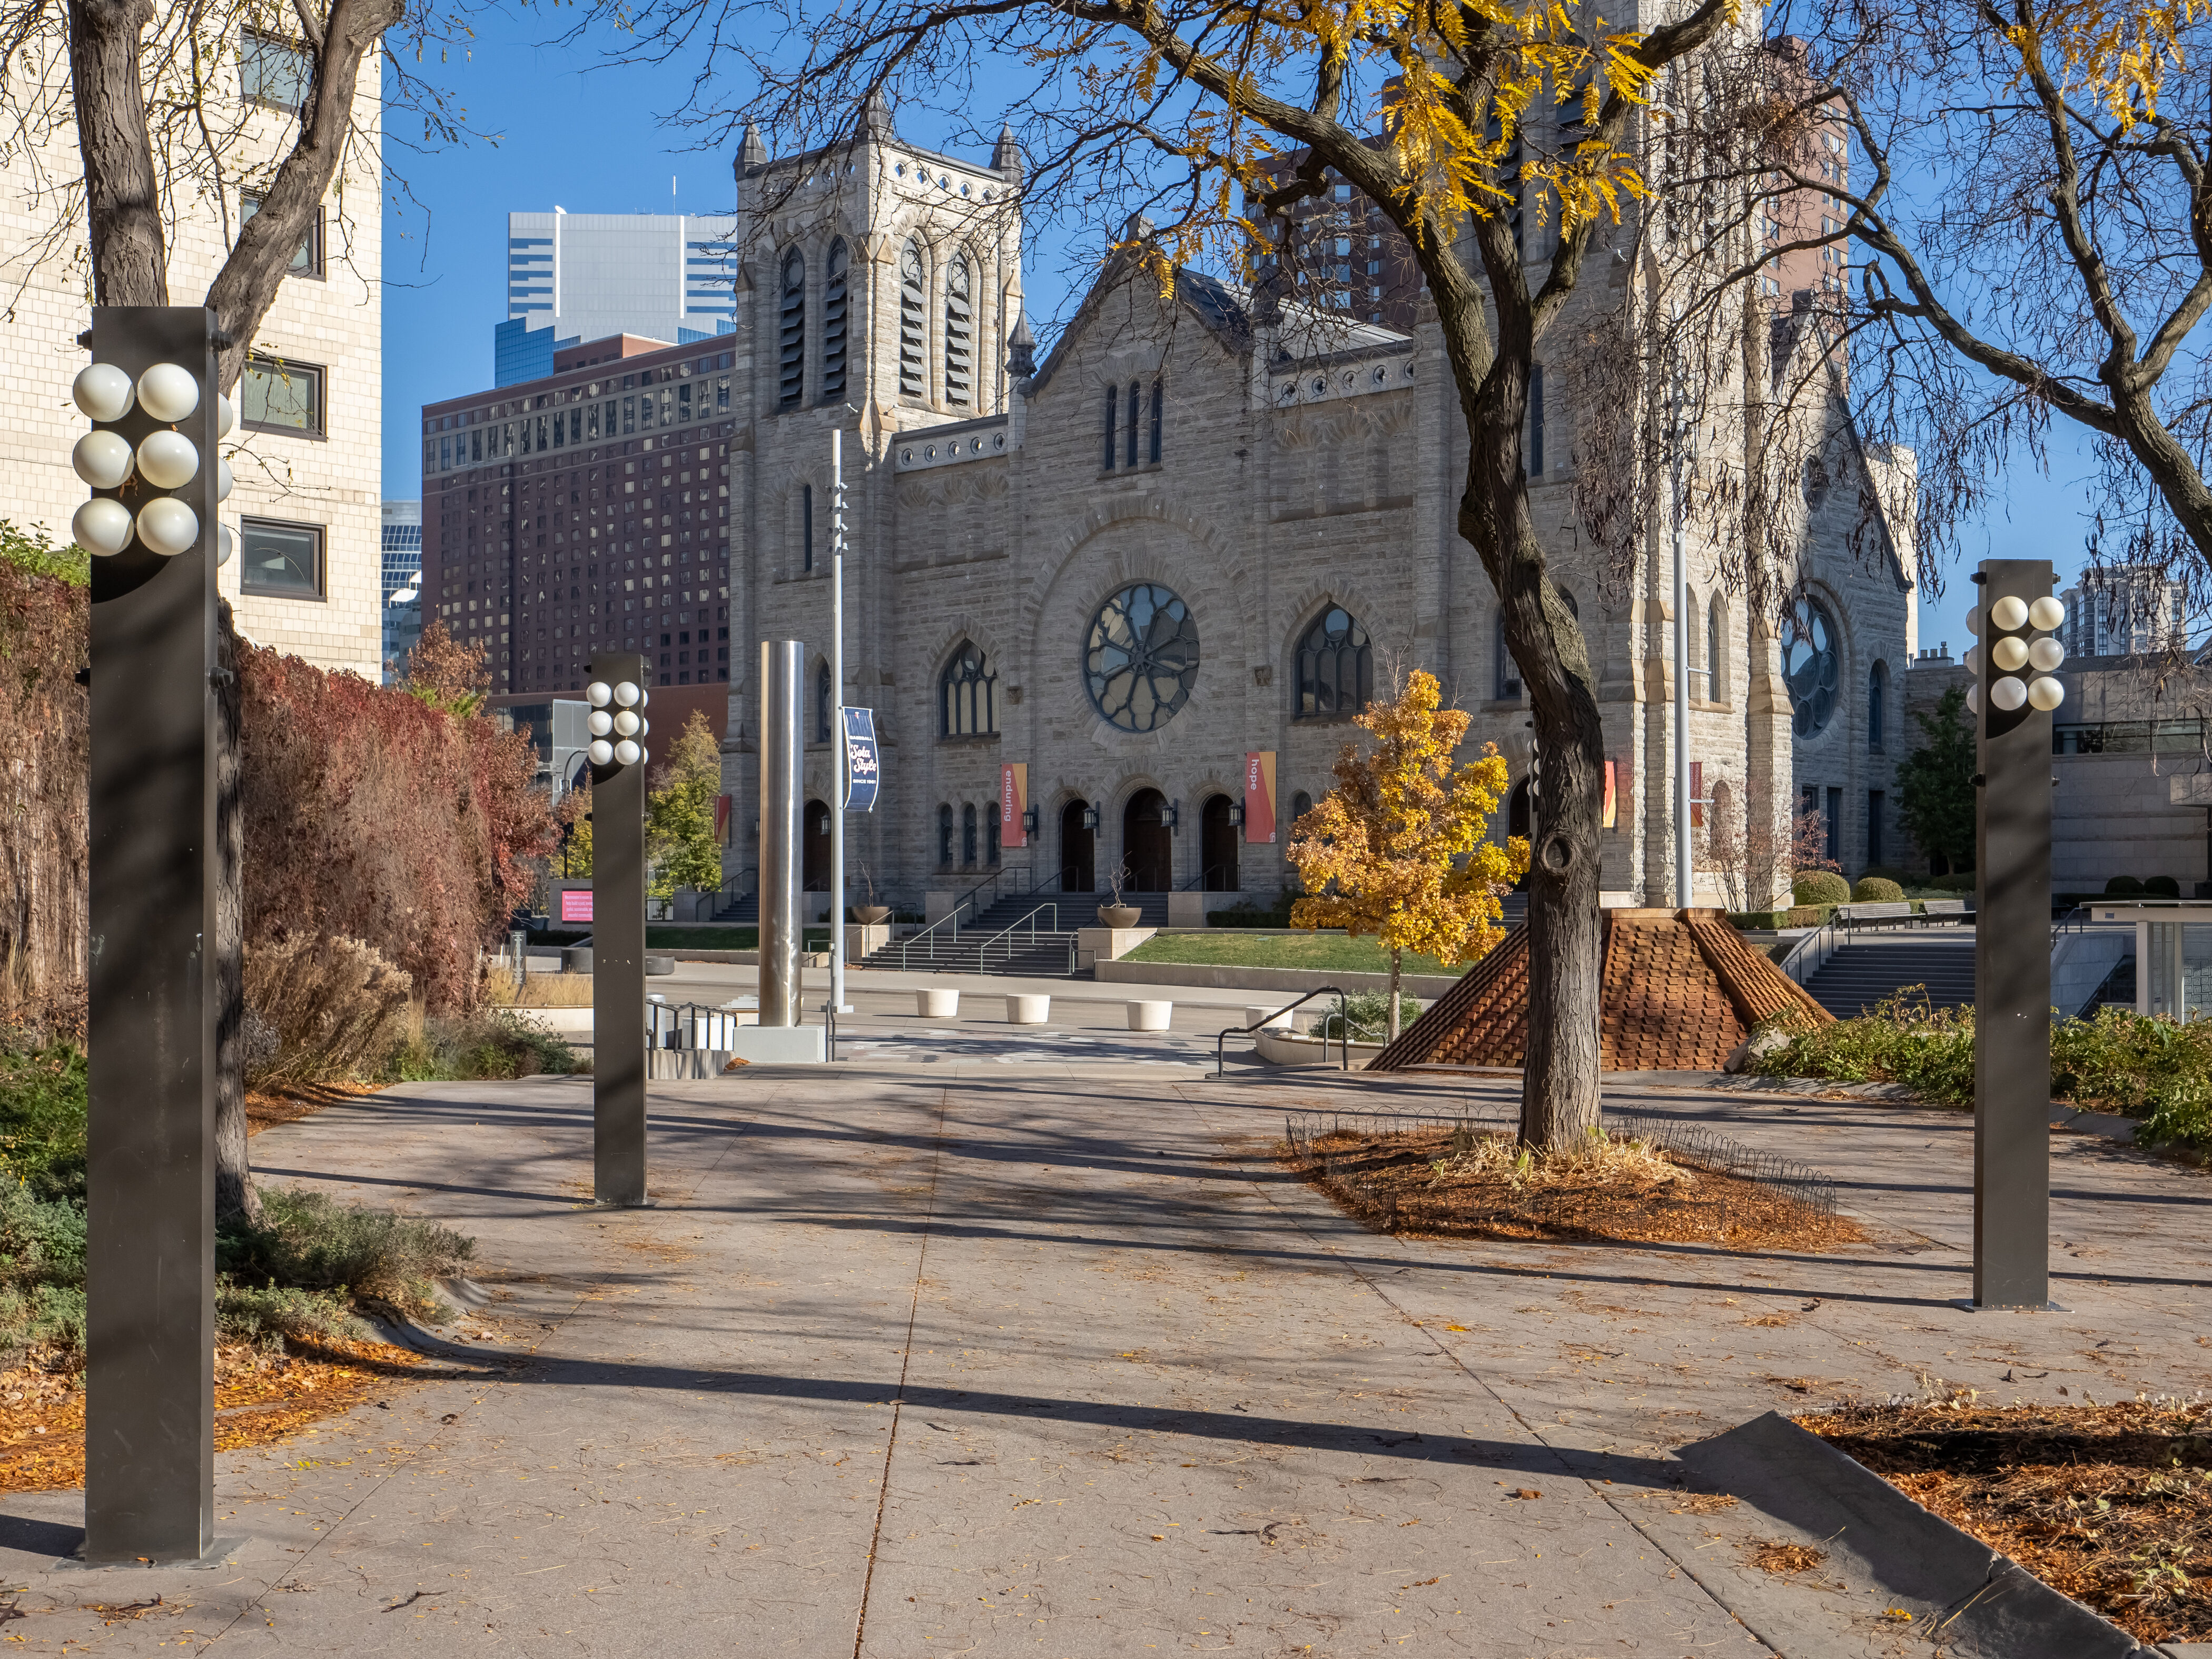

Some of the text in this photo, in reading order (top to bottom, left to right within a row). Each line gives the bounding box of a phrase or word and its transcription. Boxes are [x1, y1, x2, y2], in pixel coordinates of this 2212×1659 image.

[853, 757, 876, 775] Style
[1249, 759, 1259, 791] hope
[1004, 770, 1013, 822] enduring
